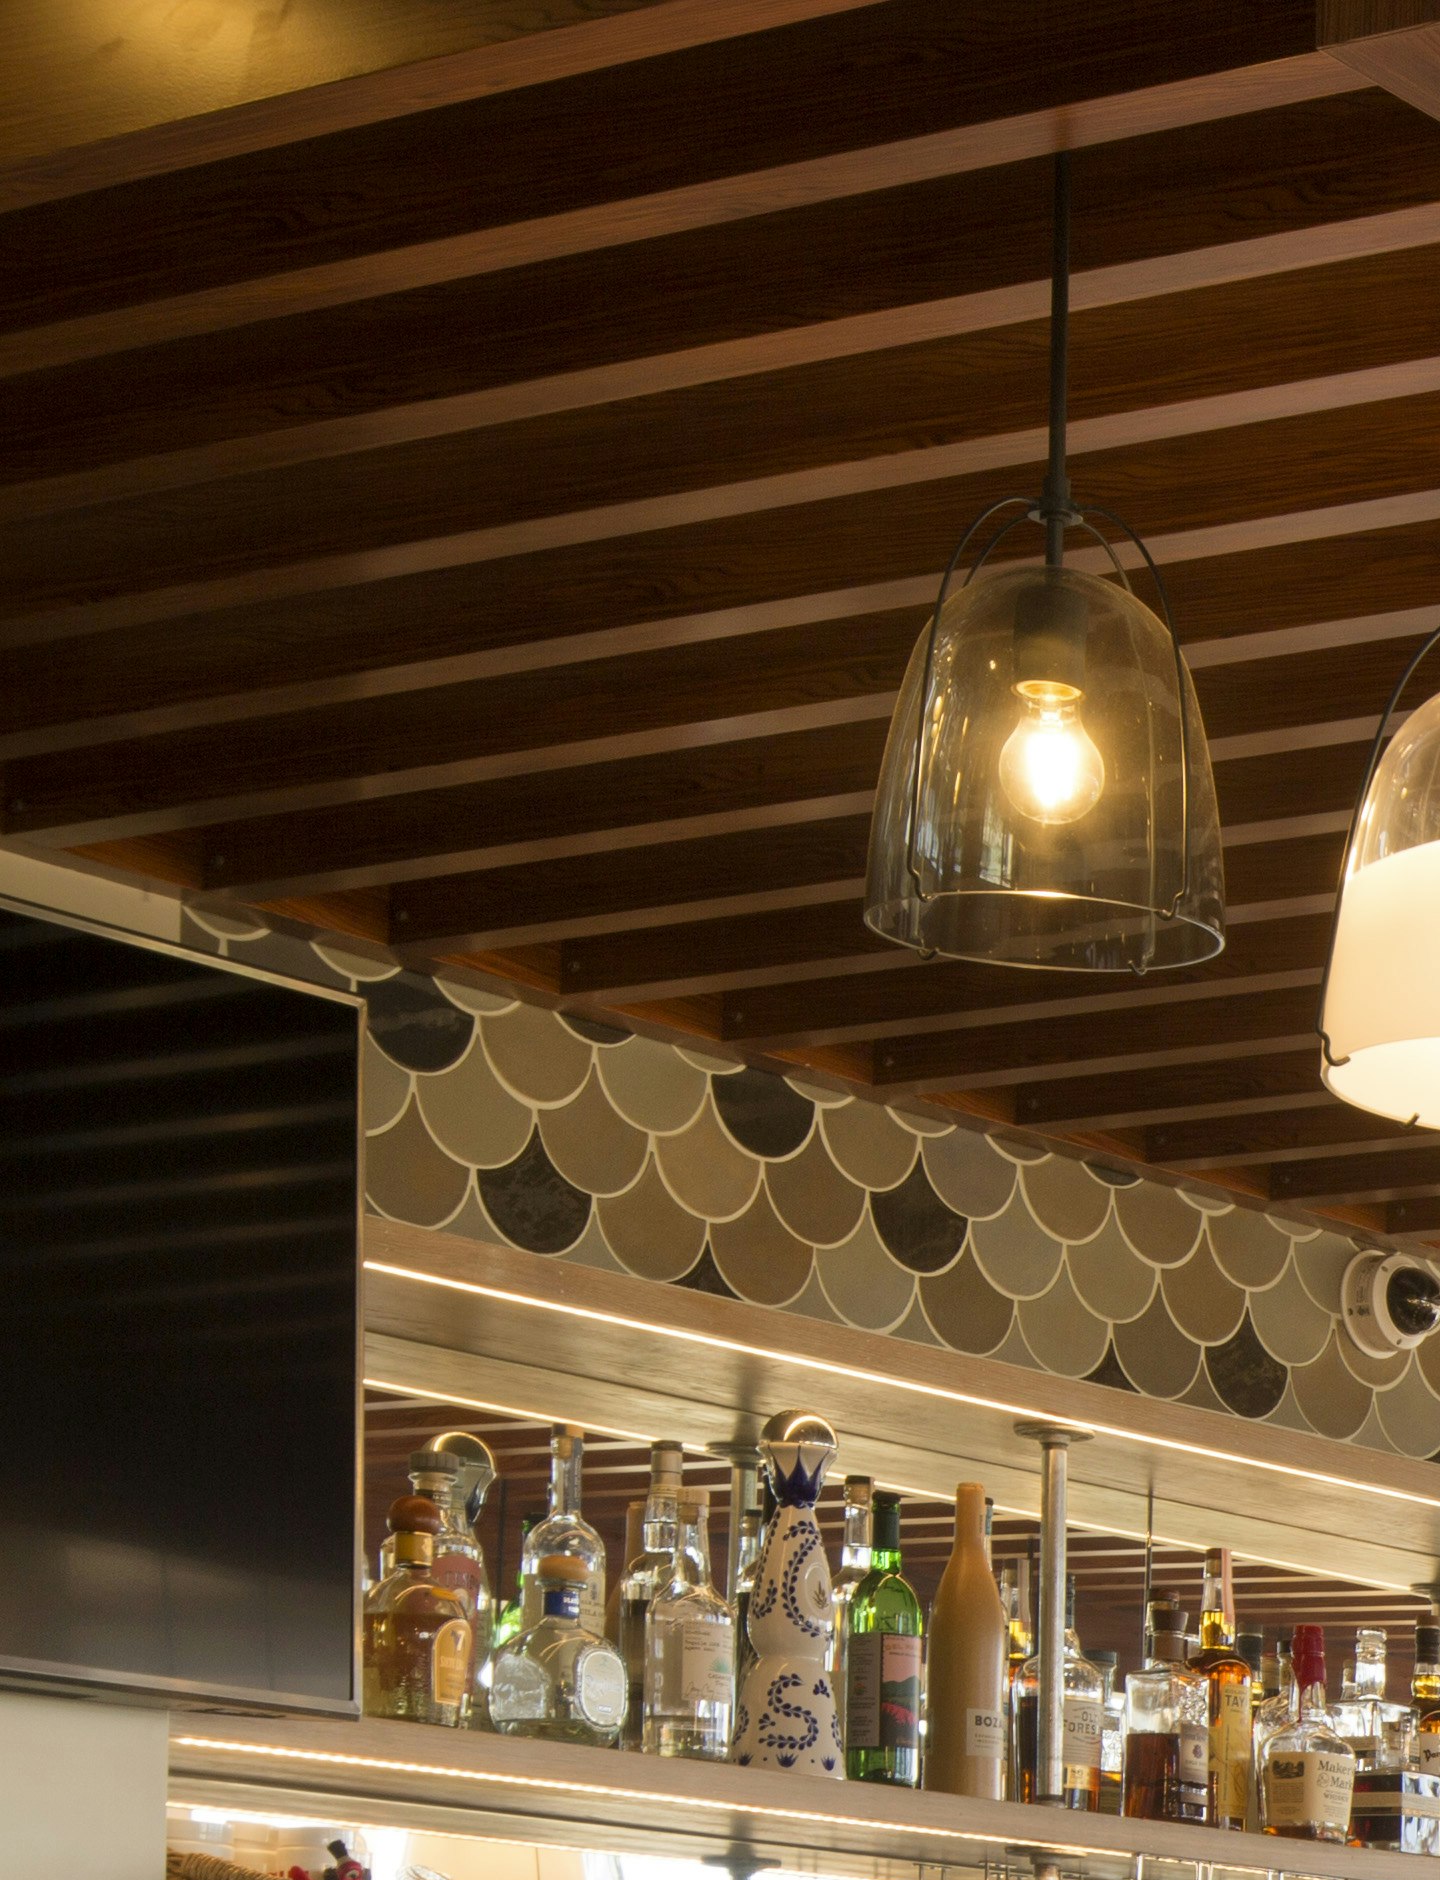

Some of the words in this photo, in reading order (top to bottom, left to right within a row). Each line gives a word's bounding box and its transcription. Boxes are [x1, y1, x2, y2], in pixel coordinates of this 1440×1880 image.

[1225, 1694, 1246, 1707] TAY
[1064, 1719, 1100, 1735] FORES
[1318, 1760, 1353, 1776] Maker
